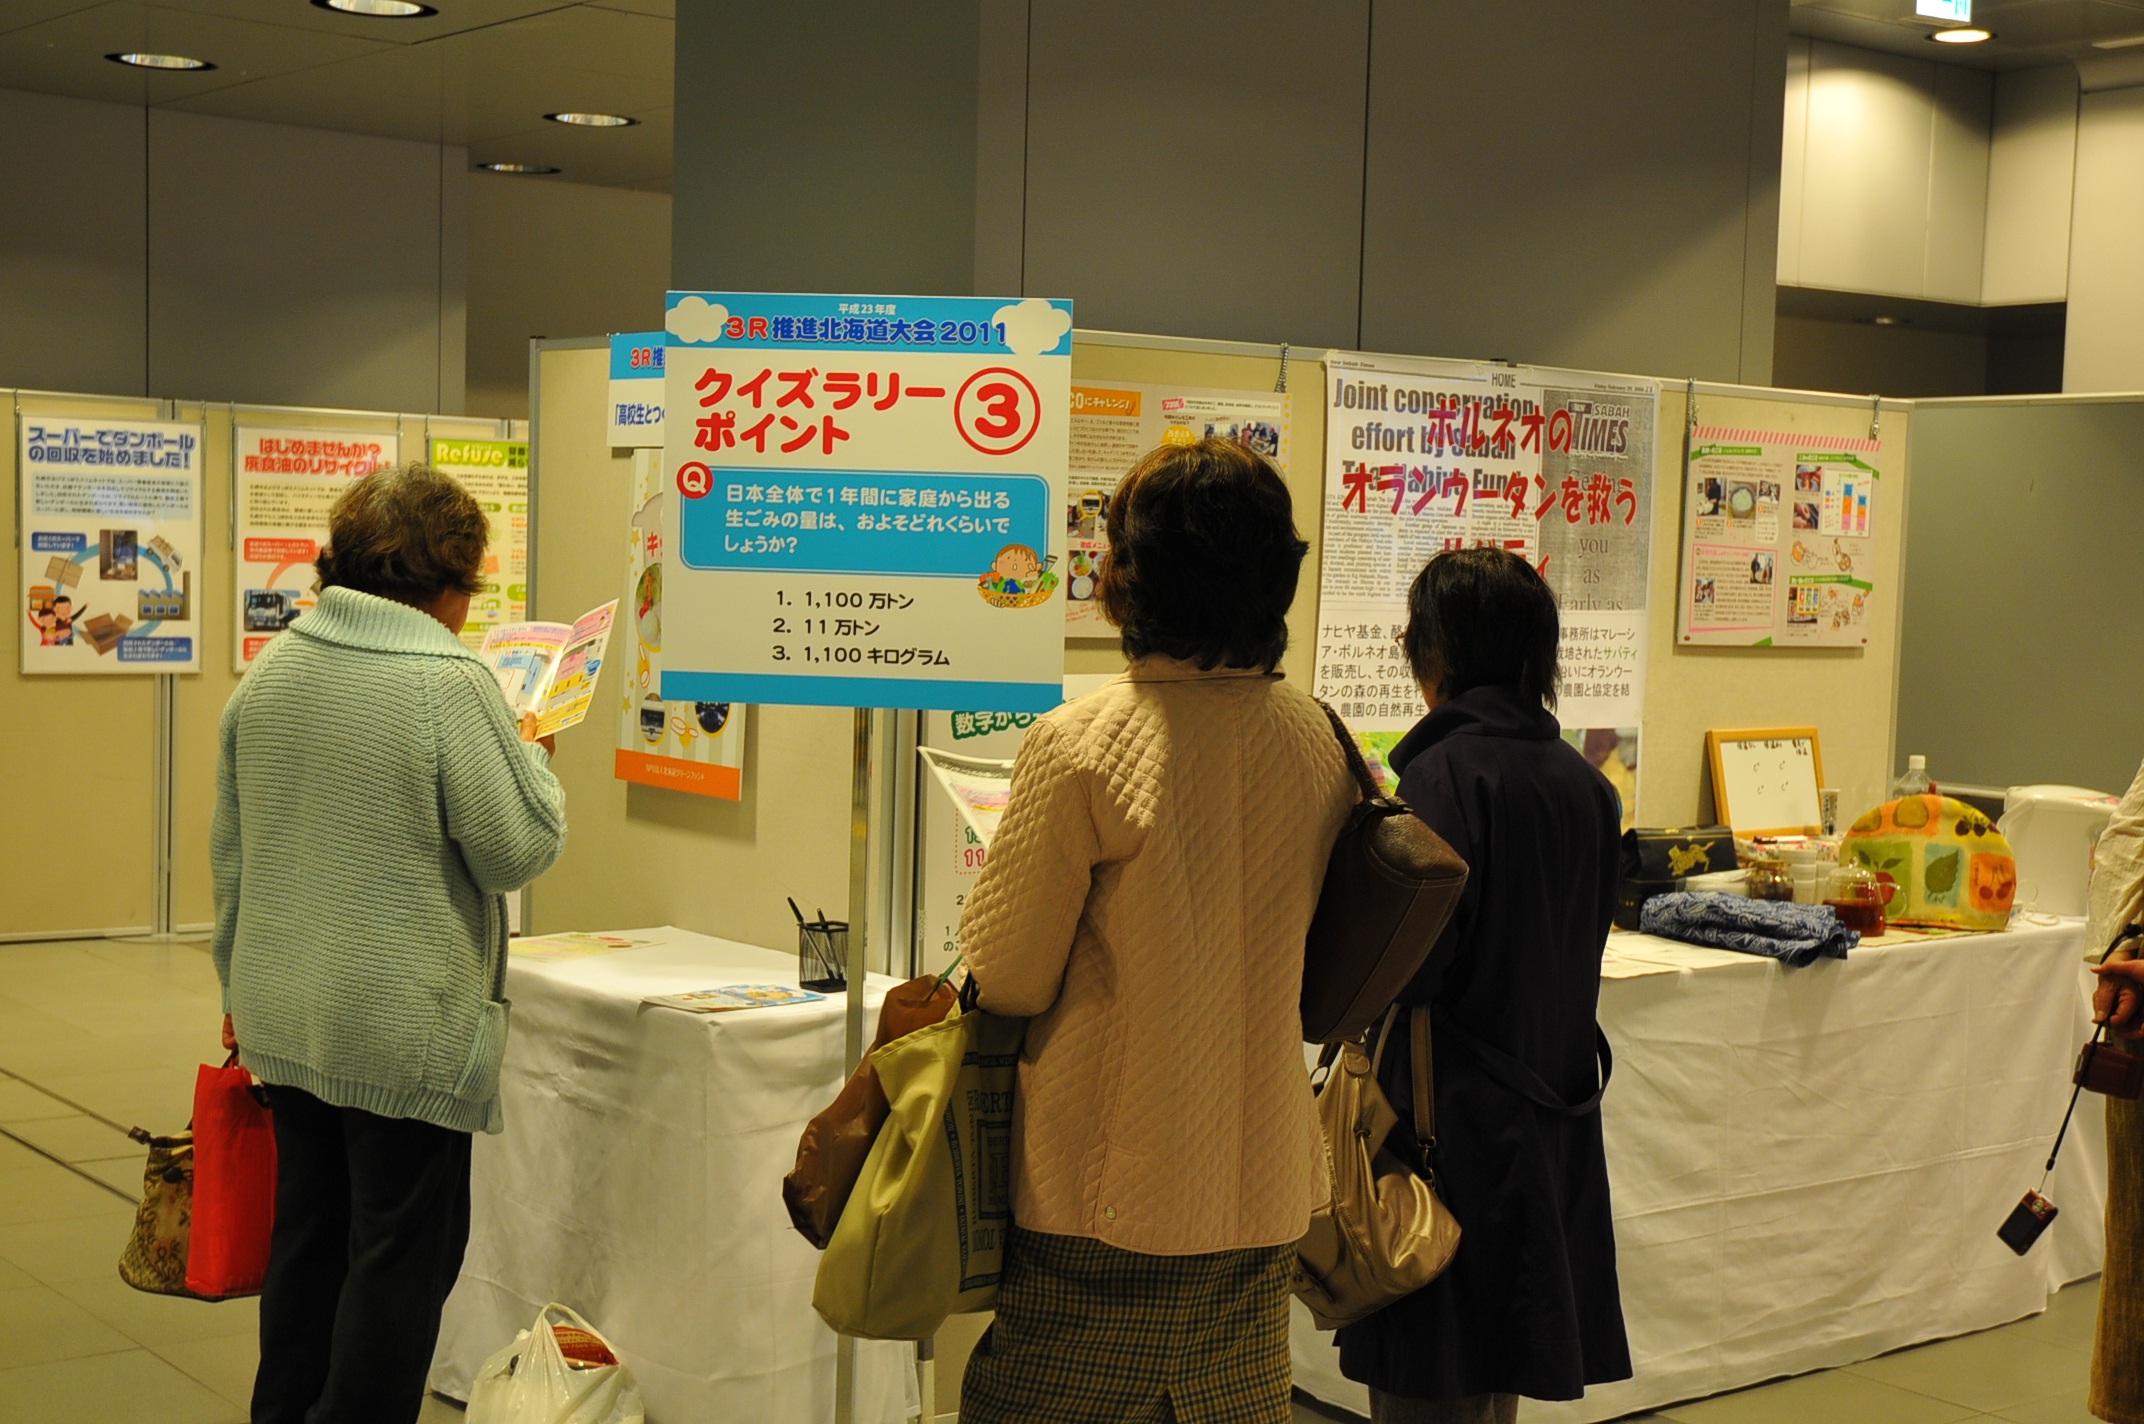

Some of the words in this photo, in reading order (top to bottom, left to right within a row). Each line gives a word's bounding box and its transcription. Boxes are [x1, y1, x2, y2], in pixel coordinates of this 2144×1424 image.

[838, 303, 897, 315] 平成23年度
[694, 366, 946, 410] クイズラリー
[1491, 372, 1517, 389] HOME
[1333, 378, 1388, 413] Joint
[1394, 388, 1534, 422] conservation
[1594, 404, 1630, 418] SABAH
[694, 411, 850, 455] ポイント
[1351, 422, 1415, 452] effort
[1427, 398, 1573, 455] ボルネオの
[1567, 401, 1630, 454] TIMES
[28, 426, 195, 451] スーパーでダンボール
[260, 438, 383, 459] はじめませんか?
[28, 445, 191, 470] の回収を始めました!
[436, 443, 504, 465] Refuse
[682, 466, 707, 494] Q
[1342, 460, 1386, 494] Ta,
[727, 484, 1011, 509] 日本全体で1年間に家庭から出る
[1341, 462, 1638, 526] オランウータンを救う
[725, 509, 1011, 534] 生ごみの量は、およそどれくらいで
[725, 534, 798, 554] しょうか?
[1579, 538, 1608, 558] you
[1584, 568, 1600, 584] as
[777, 590, 792, 606] 1.
[805, 591, 863, 609] 1,100
[868, 593, 915, 610] 万トン
[1556, 592, 1600, 611] Early
[1606, 598, 1623, 611] as
[772, 617, 792, 633] 2.
[805, 619, 826, 635] 11
[834, 619, 880, 636] 万トン
[1322, 624, 1408, 640] ナヒヤ基金、酪
[772, 645, 791, 661] 3.
[804, 647, 862, 663] 1,100
[867, 647, 951, 666] キログラム
[1320, 644, 1408, 660] ア・ボルネオ島
[1319, 663, 1416, 680] を販売し、その収
[955, 711, 1041, 736] 数字から
